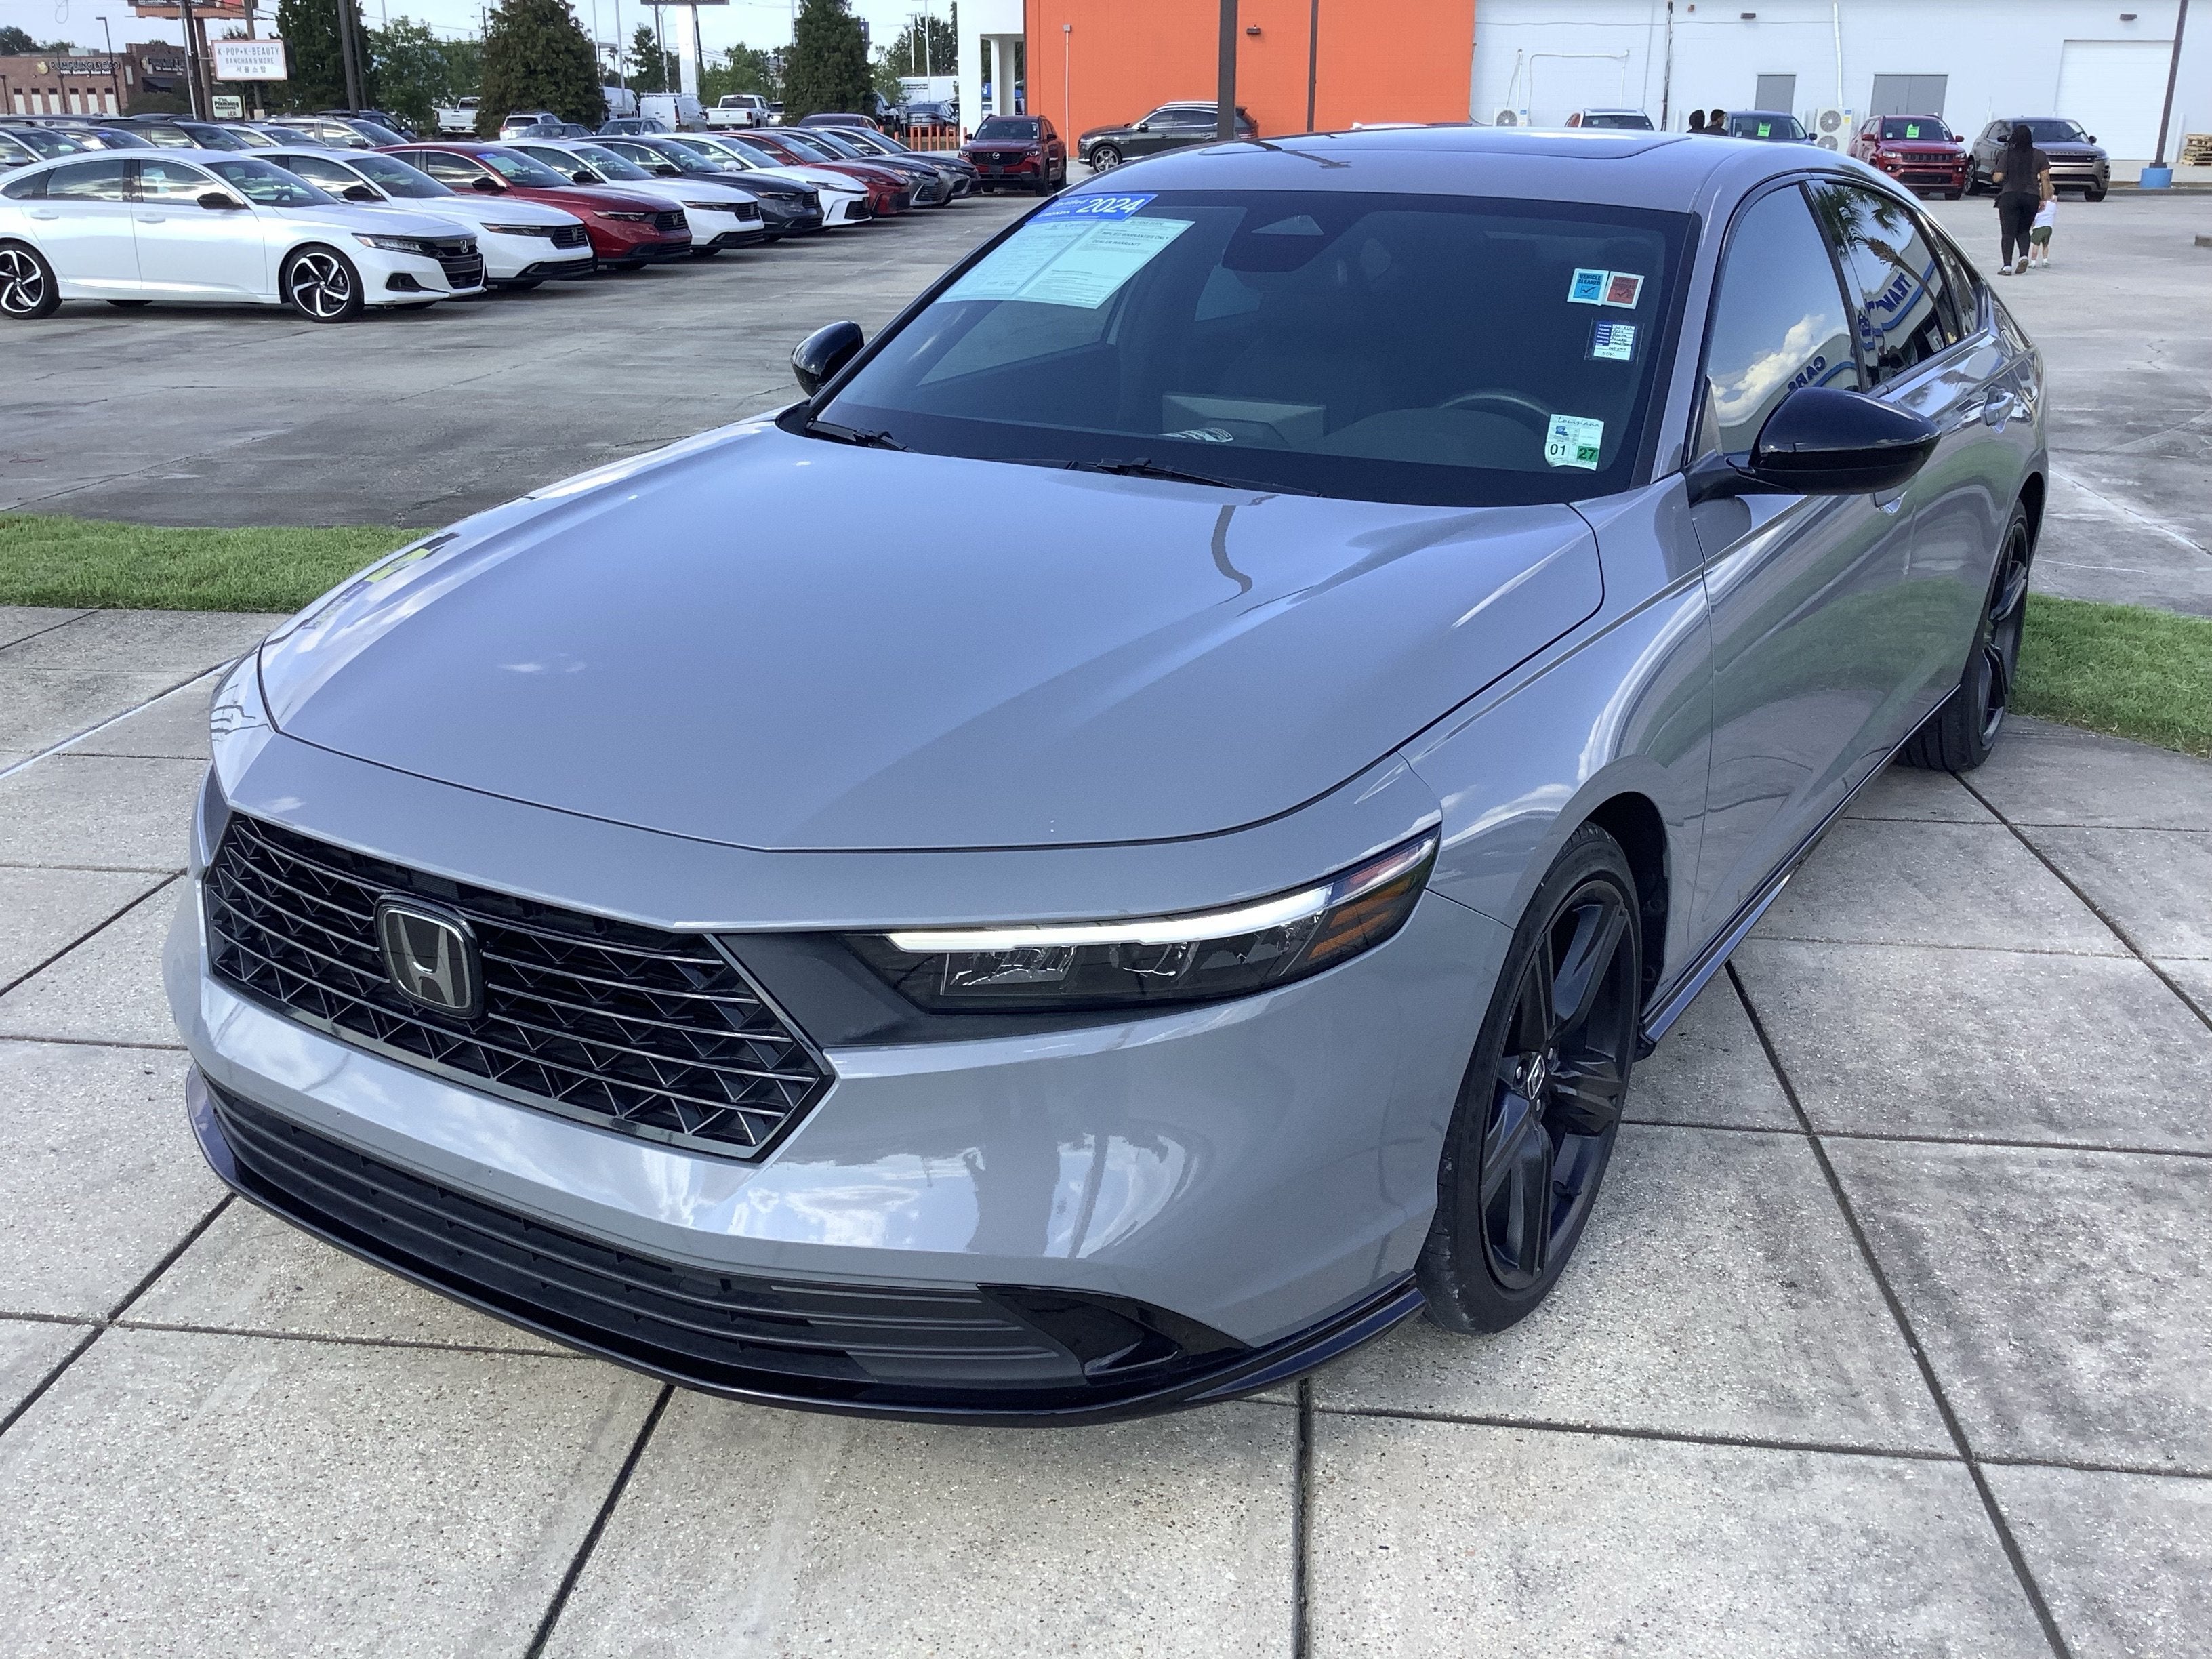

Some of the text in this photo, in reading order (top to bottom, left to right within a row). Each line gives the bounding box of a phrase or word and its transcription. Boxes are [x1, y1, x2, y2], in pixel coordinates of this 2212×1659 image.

[1076, 198, 1145, 213] 2024
[1557, 416, 1600, 428] Louisiana
[1550, 444, 1597, 460] 01 27
